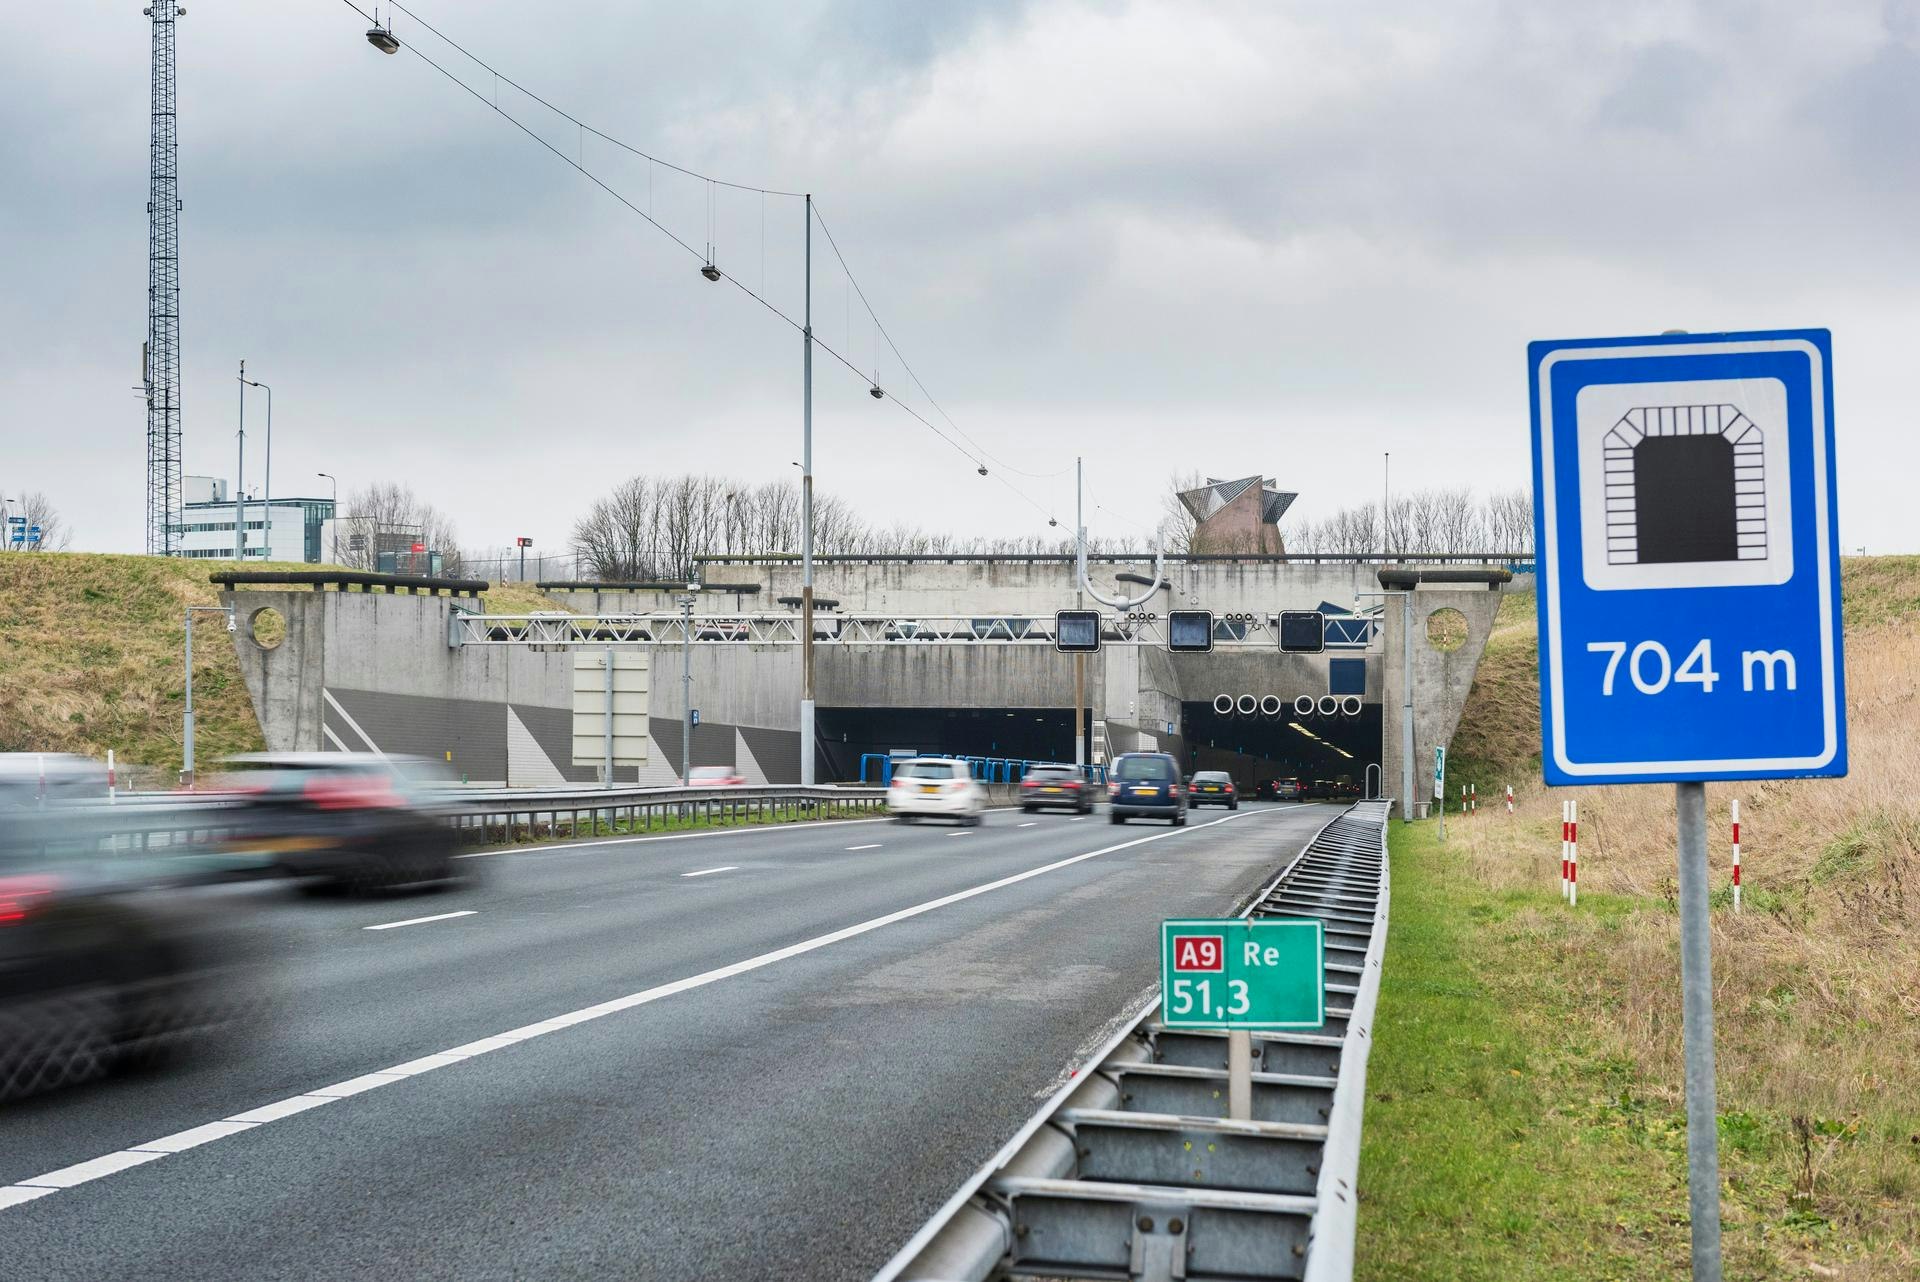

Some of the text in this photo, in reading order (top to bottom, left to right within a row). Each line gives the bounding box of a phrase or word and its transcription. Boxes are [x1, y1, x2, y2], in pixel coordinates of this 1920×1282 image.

[1587, 639, 1797, 696] 704 m
[1180, 942, 1280, 967] A9 Re
[1173, 979, 1250, 1019] 51,3
